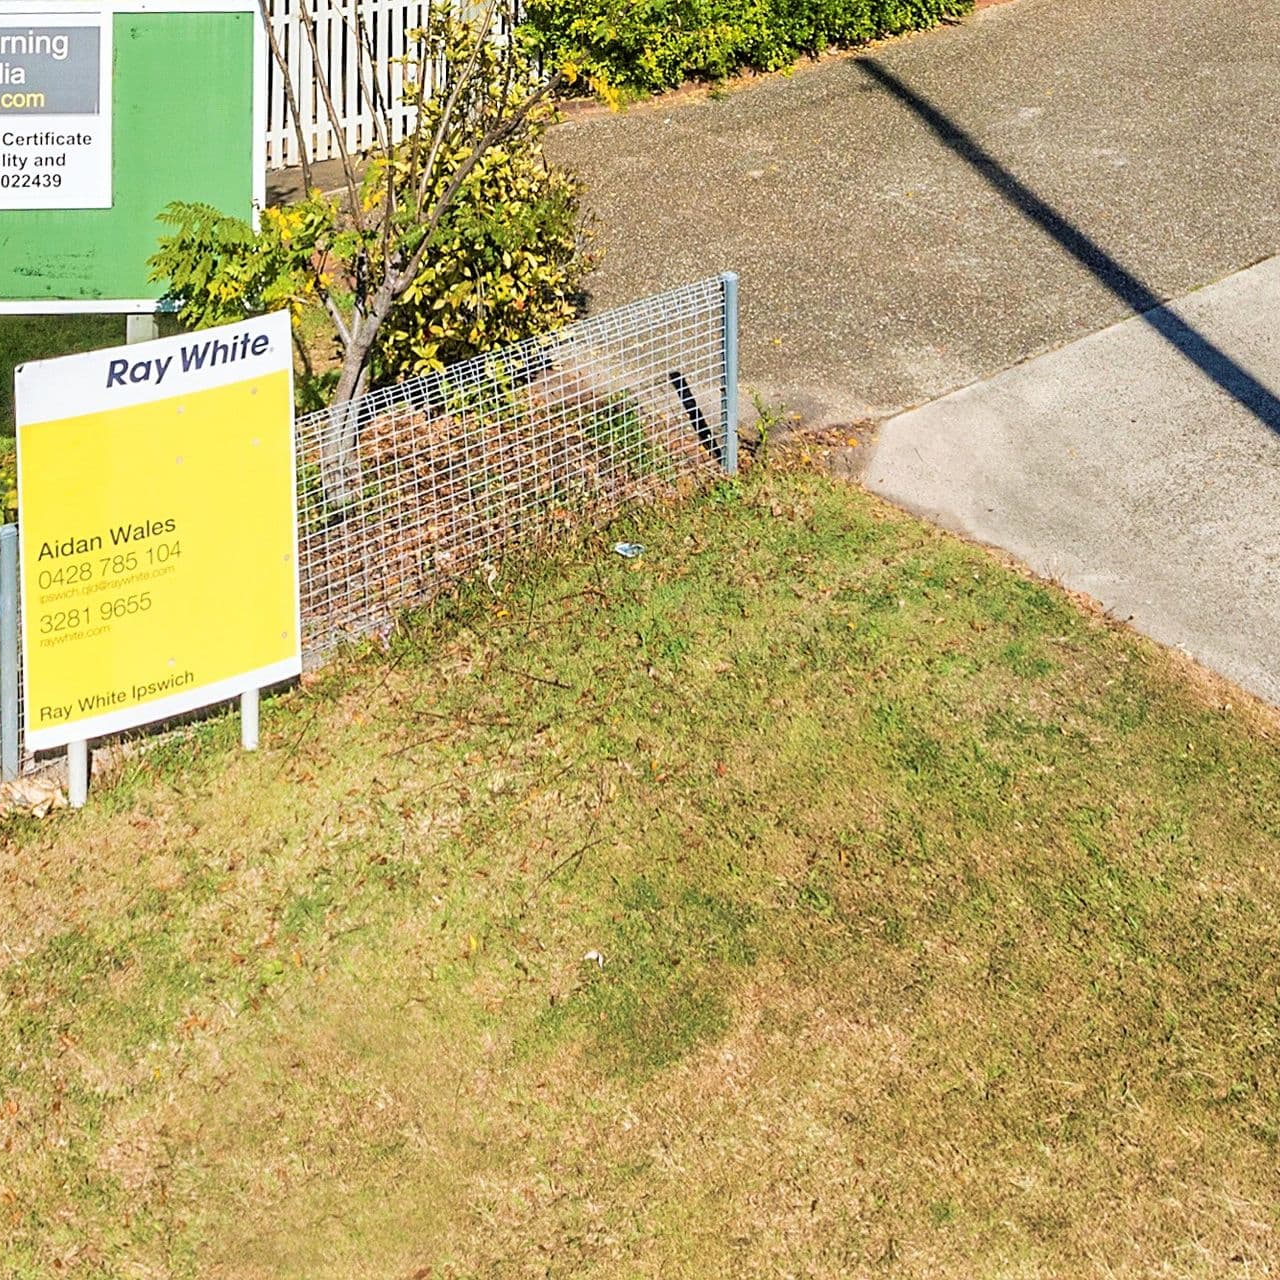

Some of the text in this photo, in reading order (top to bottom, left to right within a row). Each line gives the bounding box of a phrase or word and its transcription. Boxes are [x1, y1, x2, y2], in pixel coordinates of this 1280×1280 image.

[2, 132, 92, 146] Certificate
[34, 153, 66, 167] and
[106, 332, 269, 388] Ray White
[38, 518, 176, 561] Aidan Wales
[38, 540, 182, 590] 0428 785 104
[40, 592, 152, 634] 3281 9655
[39, 624, 111, 648] raywhite.com
[40, 670, 194, 721] Ray White Ipswich
